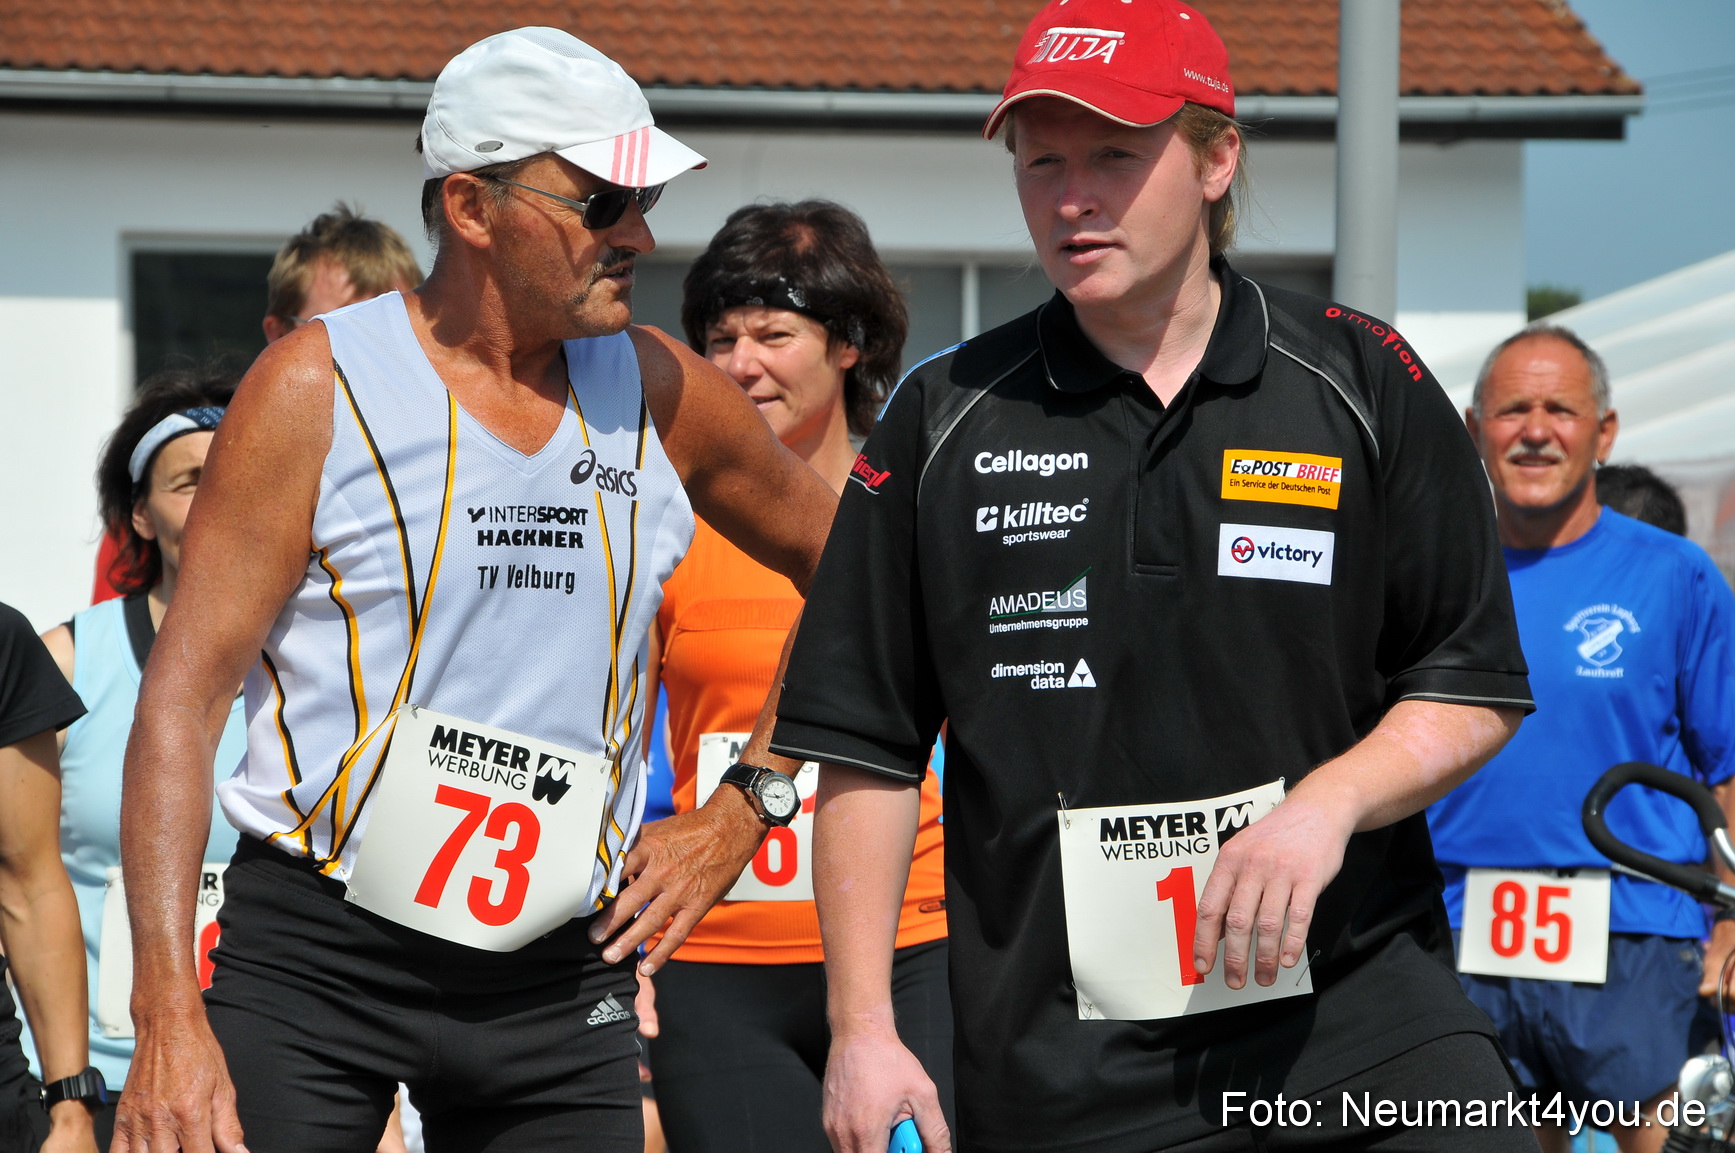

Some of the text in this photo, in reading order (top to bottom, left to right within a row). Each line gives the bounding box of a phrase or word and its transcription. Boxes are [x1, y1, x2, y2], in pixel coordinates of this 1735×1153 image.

[973, 449, 1089, 477] Cellagon
[1296, 464, 1340, 482] BRIEF
[595, 463, 638, 497] asics
[1229, 479, 1331, 495] Ein Service der Deutschen Post
[489, 505, 589, 526] INTERSPORT
[1003, 502, 1088, 529] killtec
[477, 529, 584, 549] HACKNER
[1002, 528, 1071, 546] sportswear
[1257, 541, 1324, 568] victory
[477, 564, 576, 595] TV Velburg
[989, 588, 1087, 616] AMADEUS
[989, 617, 1089, 634] Unternehmensgruppe
[991, 660, 1065, 679] dimension
[1030, 675, 1066, 690] data
[429, 724, 531, 773] MEYER
[428, 749, 527, 791] WERBUNG
[1100, 811, 1209, 842] MEYER
[413, 783, 541, 927] 73
[1100, 837, 1211, 861] WERBUNG
[1156, 866, 1205, 986] 1
[1490, 880, 1573, 964] 85
[586, 1010, 631, 1026] adidas
